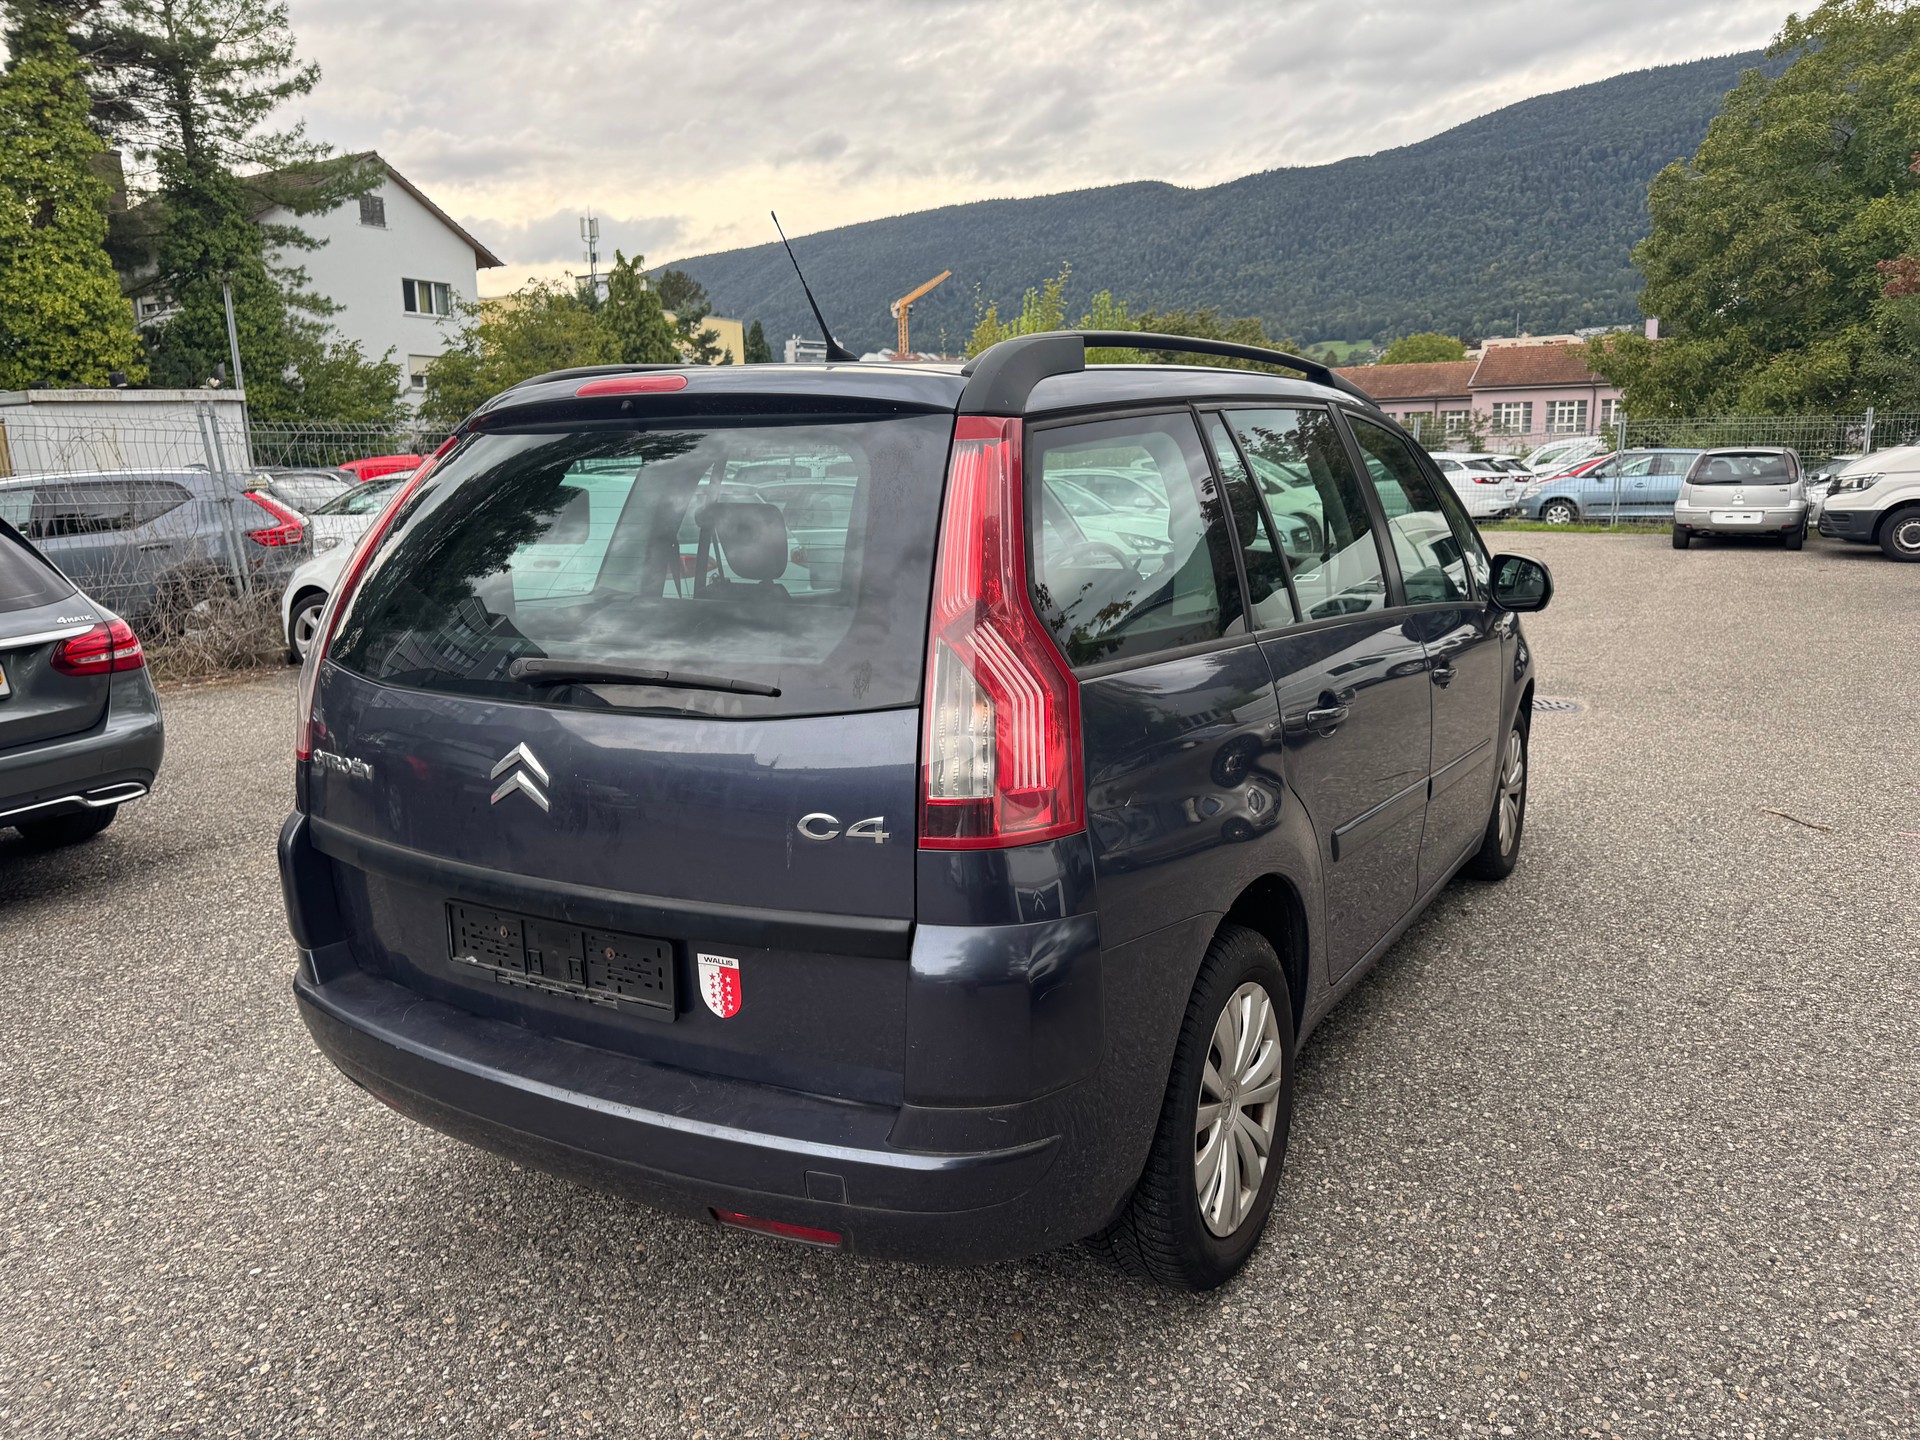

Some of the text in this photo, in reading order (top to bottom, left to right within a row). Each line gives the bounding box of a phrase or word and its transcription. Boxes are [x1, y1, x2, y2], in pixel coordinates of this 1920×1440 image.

[57, 614, 94, 624] 4MATIC
[313, 748, 374, 781] CITROËN
[797, 812, 891, 844] C4
[704, 956, 733, 966] WALLIS
